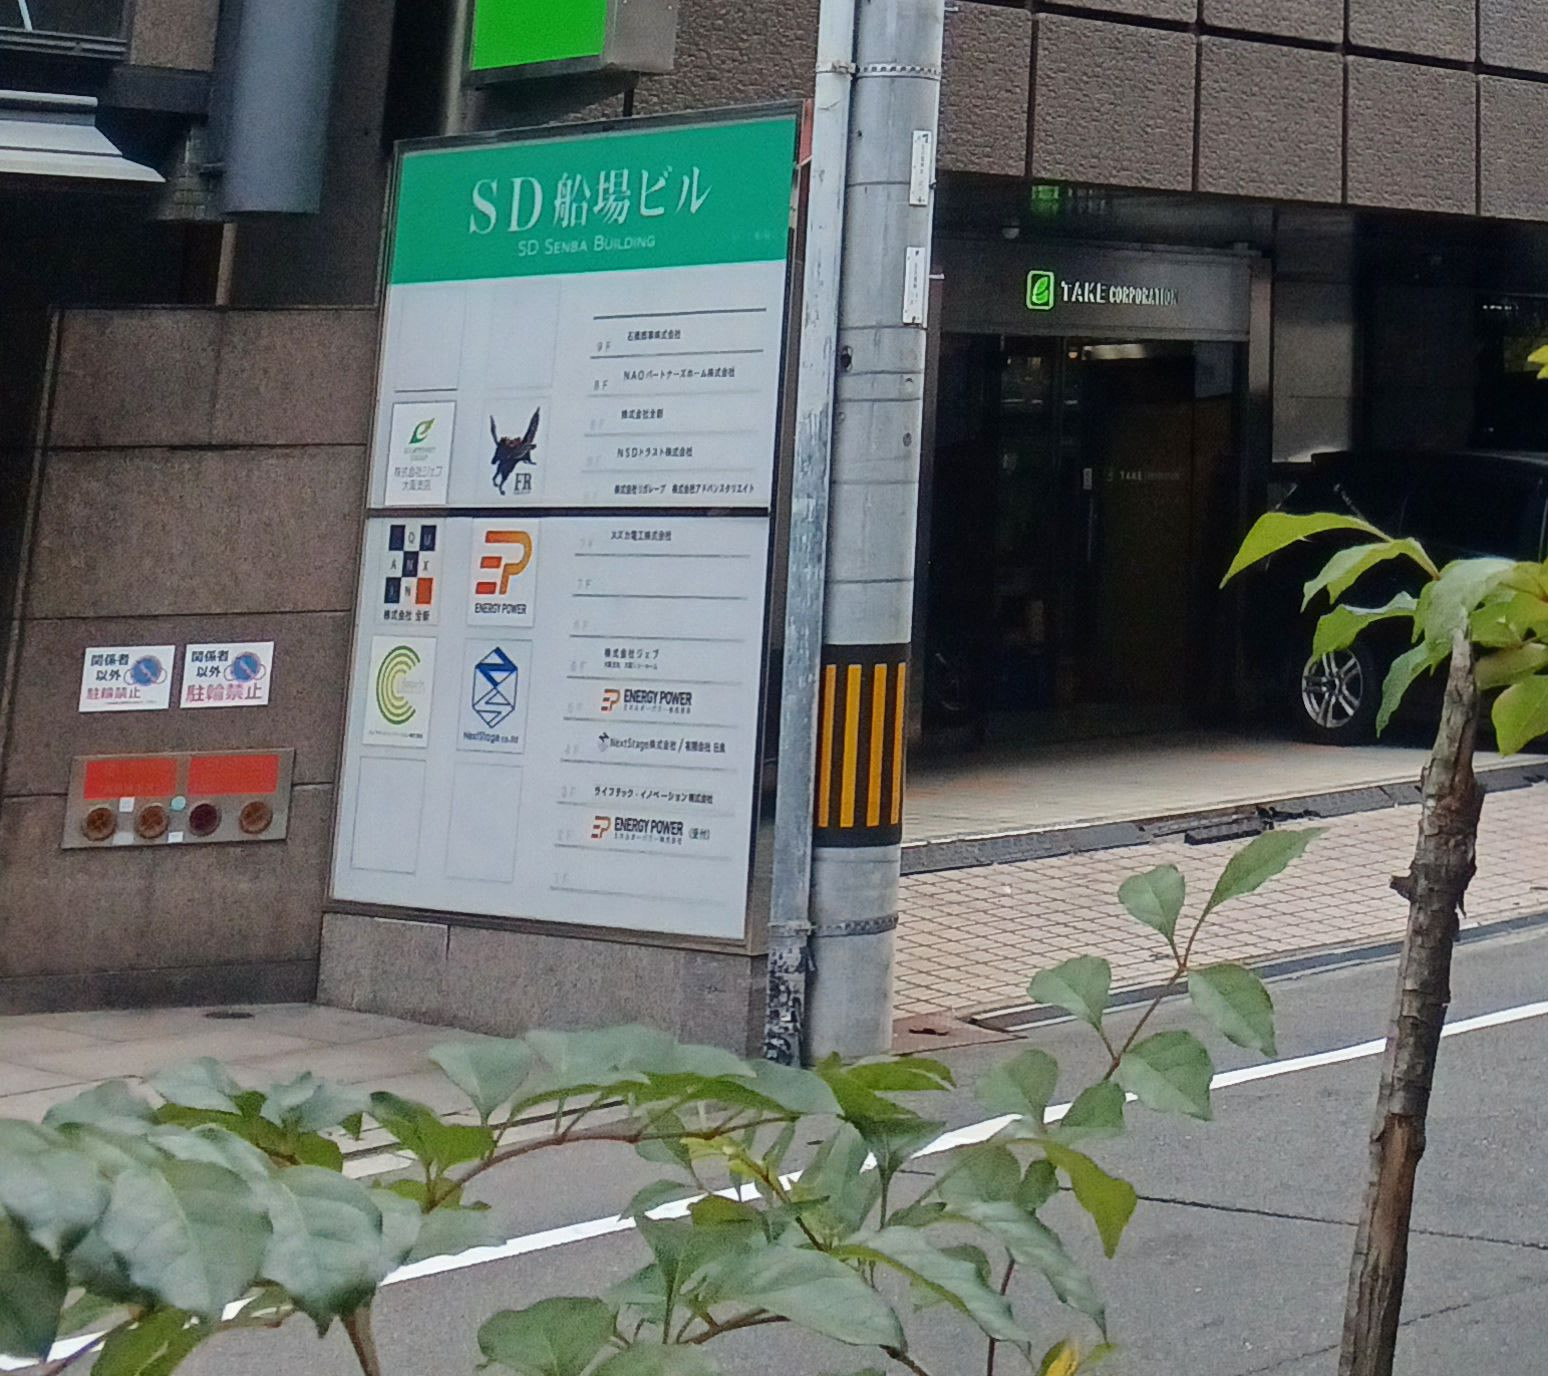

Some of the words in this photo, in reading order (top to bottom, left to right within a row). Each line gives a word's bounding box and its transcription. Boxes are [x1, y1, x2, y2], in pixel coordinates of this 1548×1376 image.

[518, 239, 538, 256] SD
[1060, 280, 1107, 304] TAKE
[1109, 285, 1178, 306] CORPORATION
[514, 473, 533, 491] FR
[90, 652, 130, 667] 関係者
[190, 649, 230, 664] 関係者
[95, 669, 122, 682] 以外
[196, 665, 221, 678] 以外
[186, 682, 263, 704] 駐輪禁止
[623, 689, 659, 705] ENERGY
[659, 690, 692, 706] POWER
[614, 816, 650, 833] ENERGY
[650, 818, 684, 836] POWER
